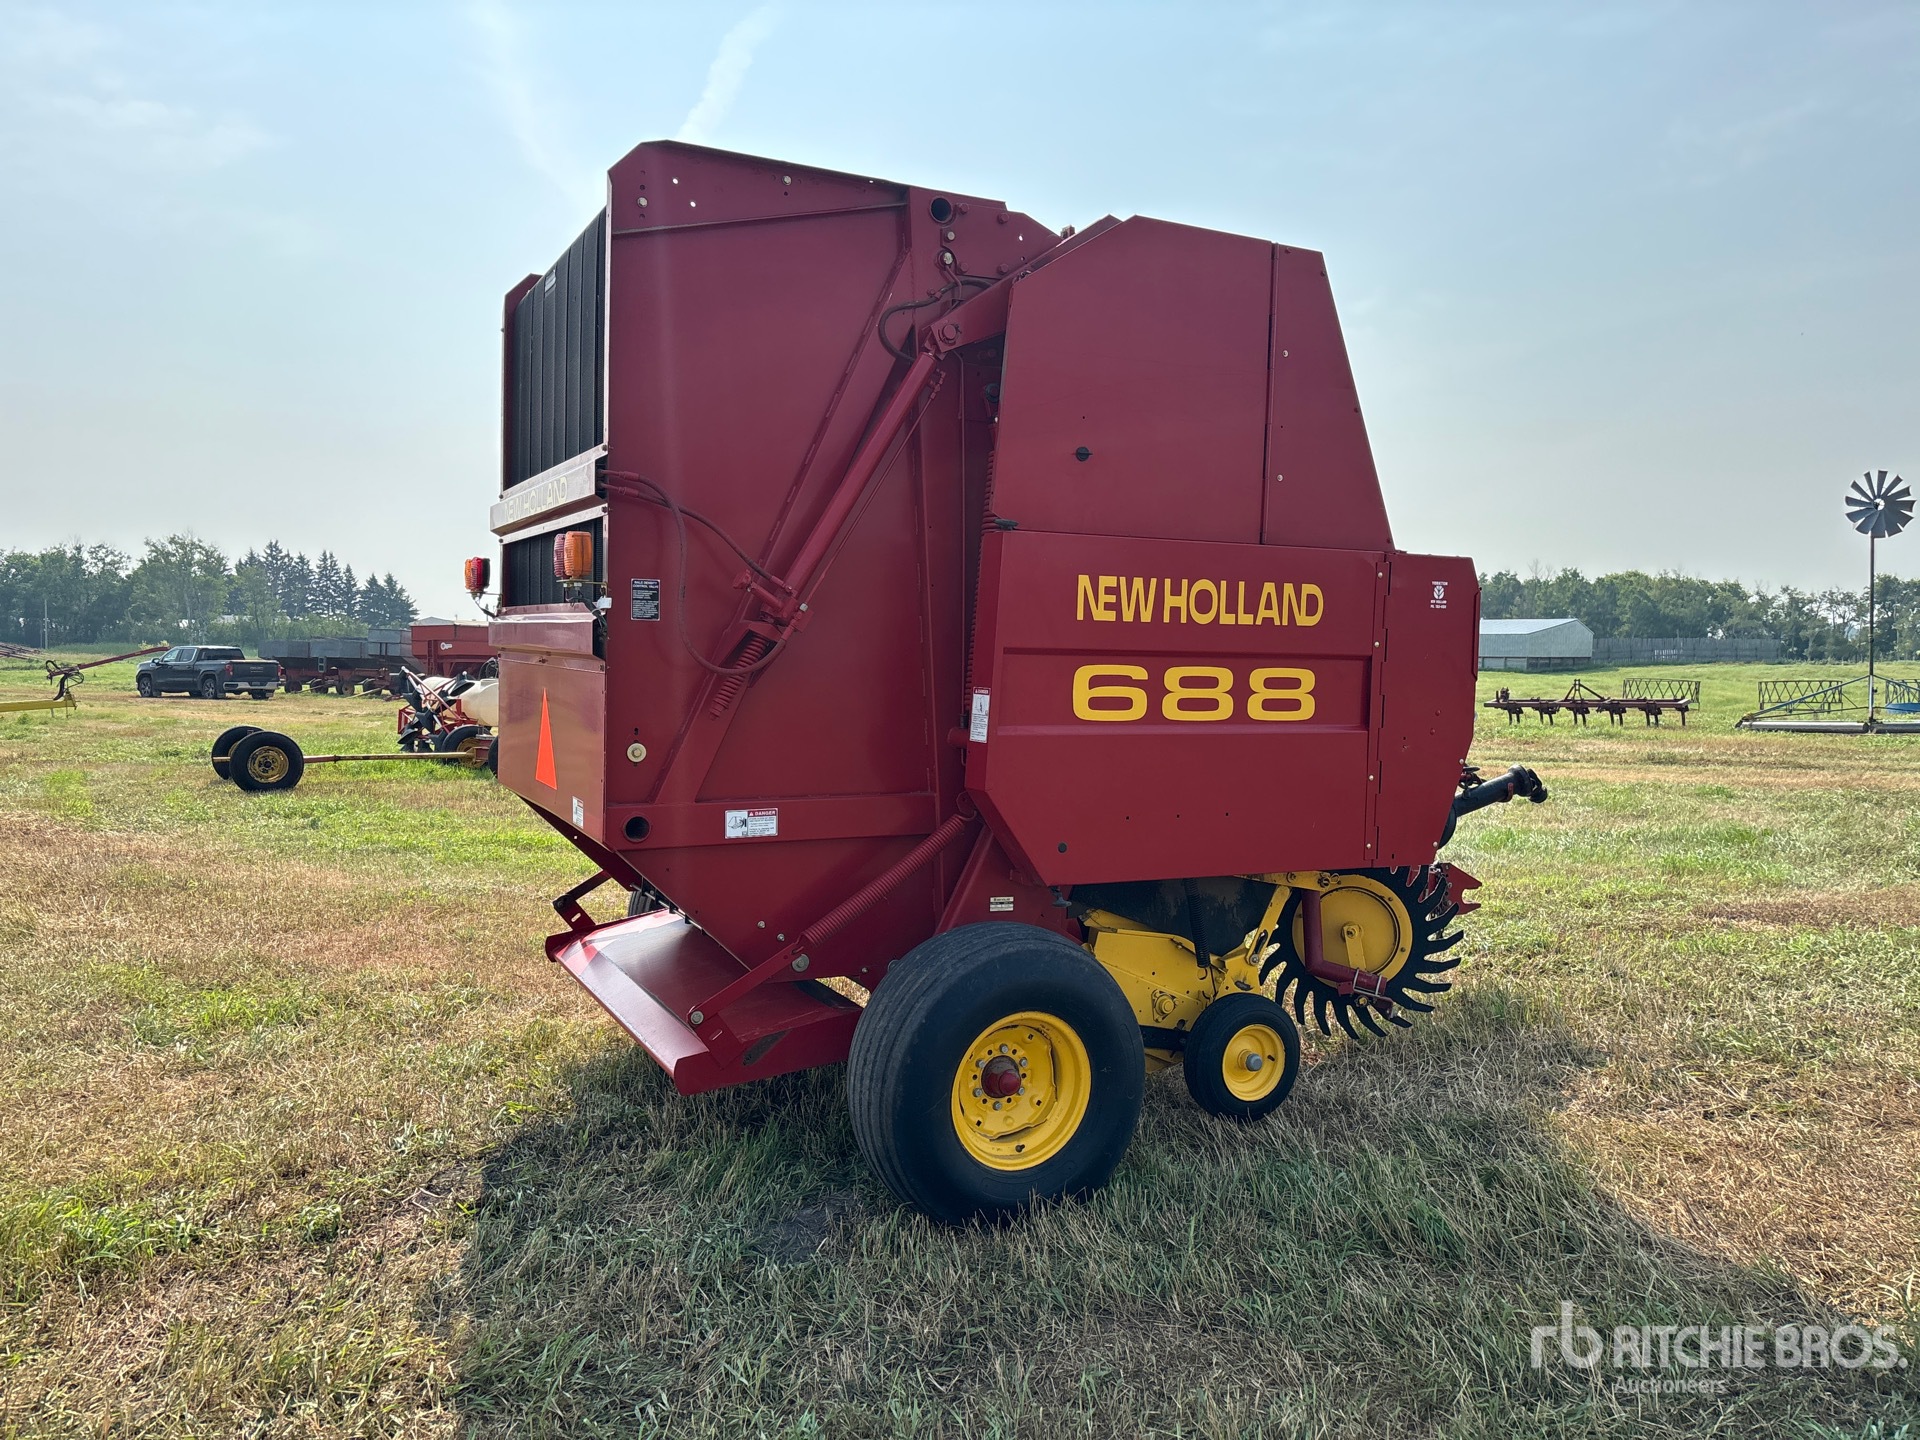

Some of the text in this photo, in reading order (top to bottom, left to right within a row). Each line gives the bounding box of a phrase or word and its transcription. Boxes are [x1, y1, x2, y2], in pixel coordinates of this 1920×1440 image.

[523, 476, 568, 515] HOLLAND
[1076, 574, 1324, 627] NEW HOLLAND
[1072, 664, 1316, 722] 688
